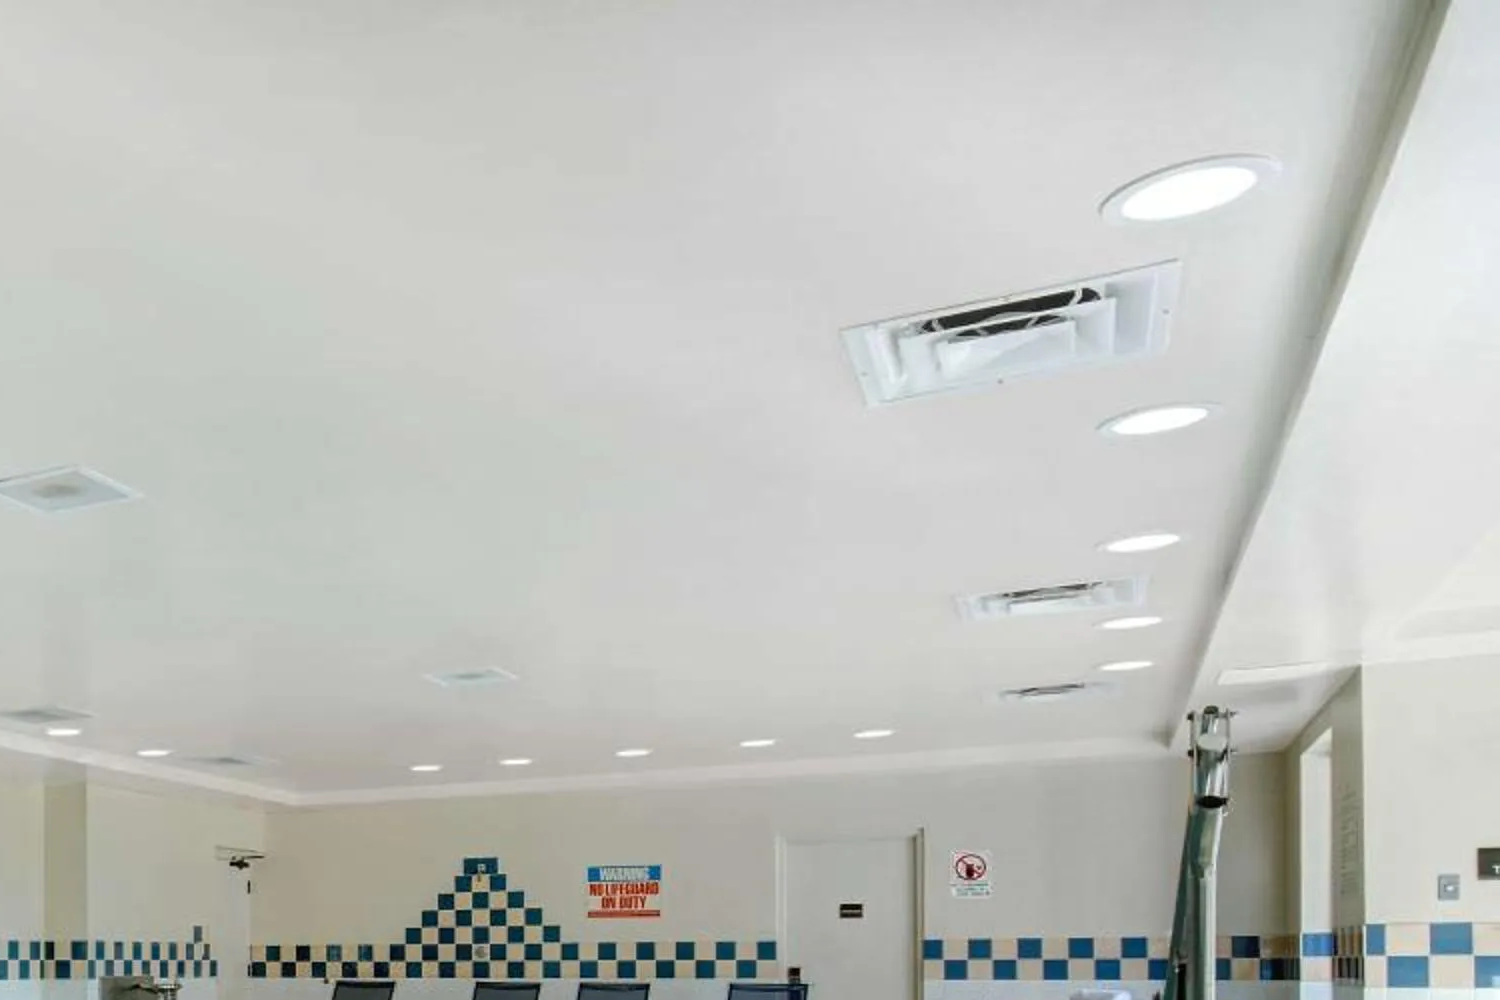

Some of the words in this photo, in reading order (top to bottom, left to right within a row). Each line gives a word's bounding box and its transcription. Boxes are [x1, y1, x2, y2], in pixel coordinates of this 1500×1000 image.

[589, 883, 604, 896] NO
[605, 882, 659, 896] LIFEGUARD
[619, 896, 647, 909] DUTY
